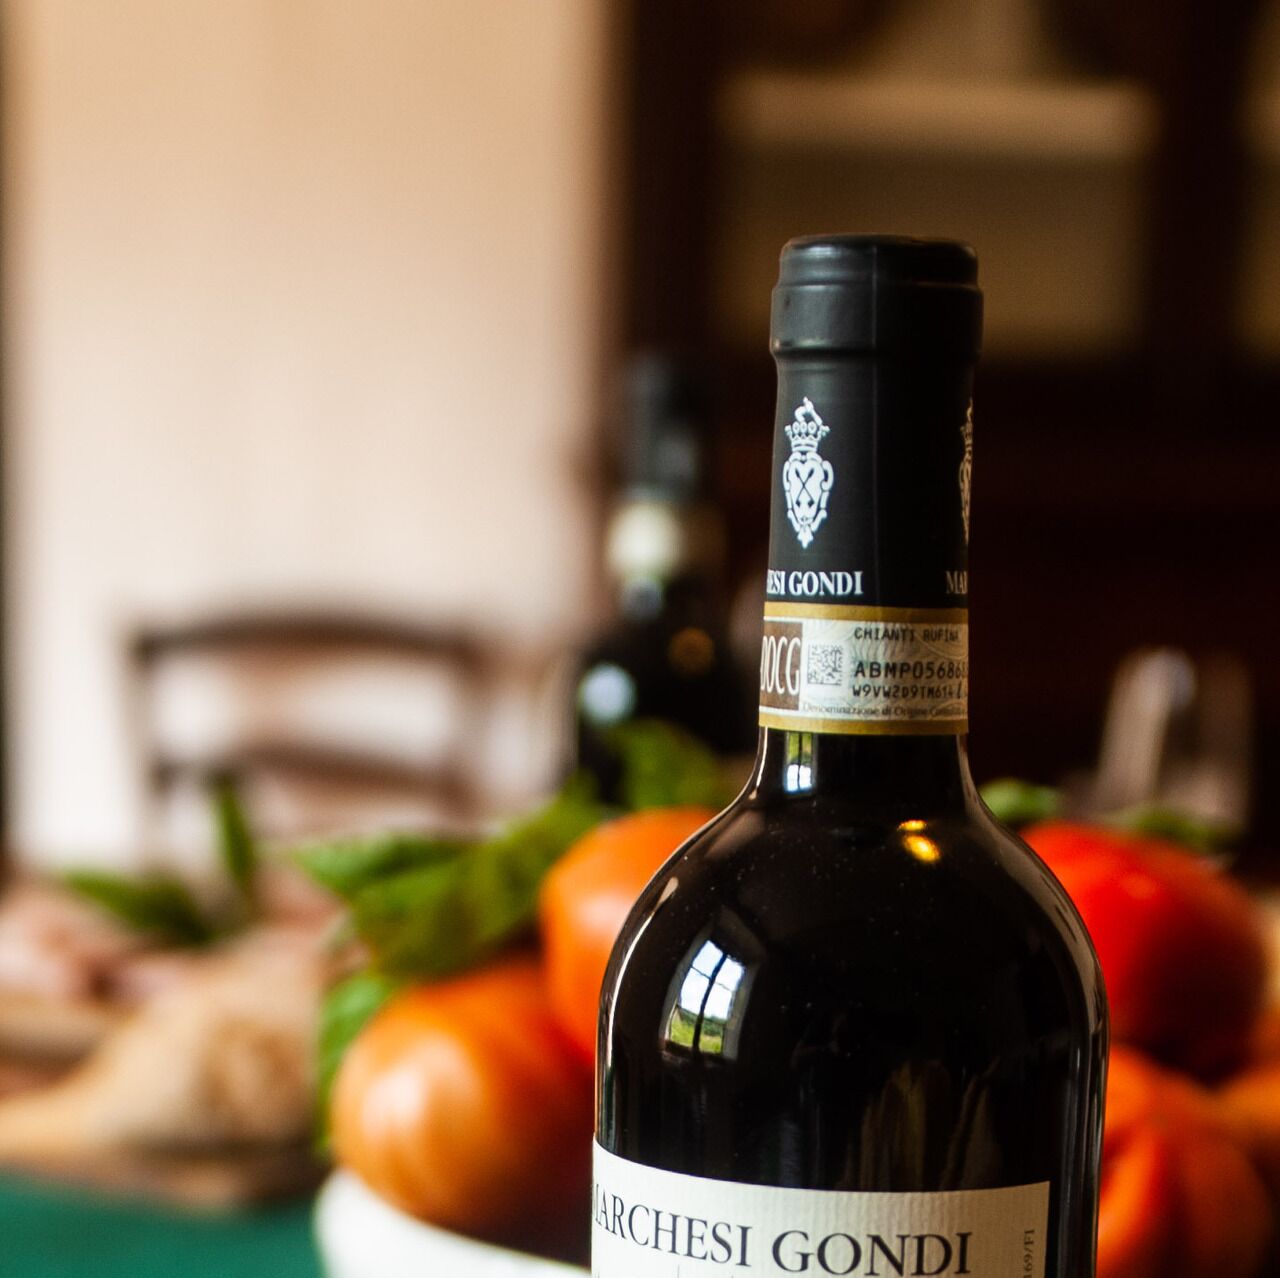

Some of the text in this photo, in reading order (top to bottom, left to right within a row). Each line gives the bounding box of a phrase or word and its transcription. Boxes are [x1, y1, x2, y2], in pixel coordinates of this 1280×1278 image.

[788, 571, 864, 596] GONDI
[853, 626, 916, 642] CHIANTI
[771, 1229, 974, 1278] GONDI
